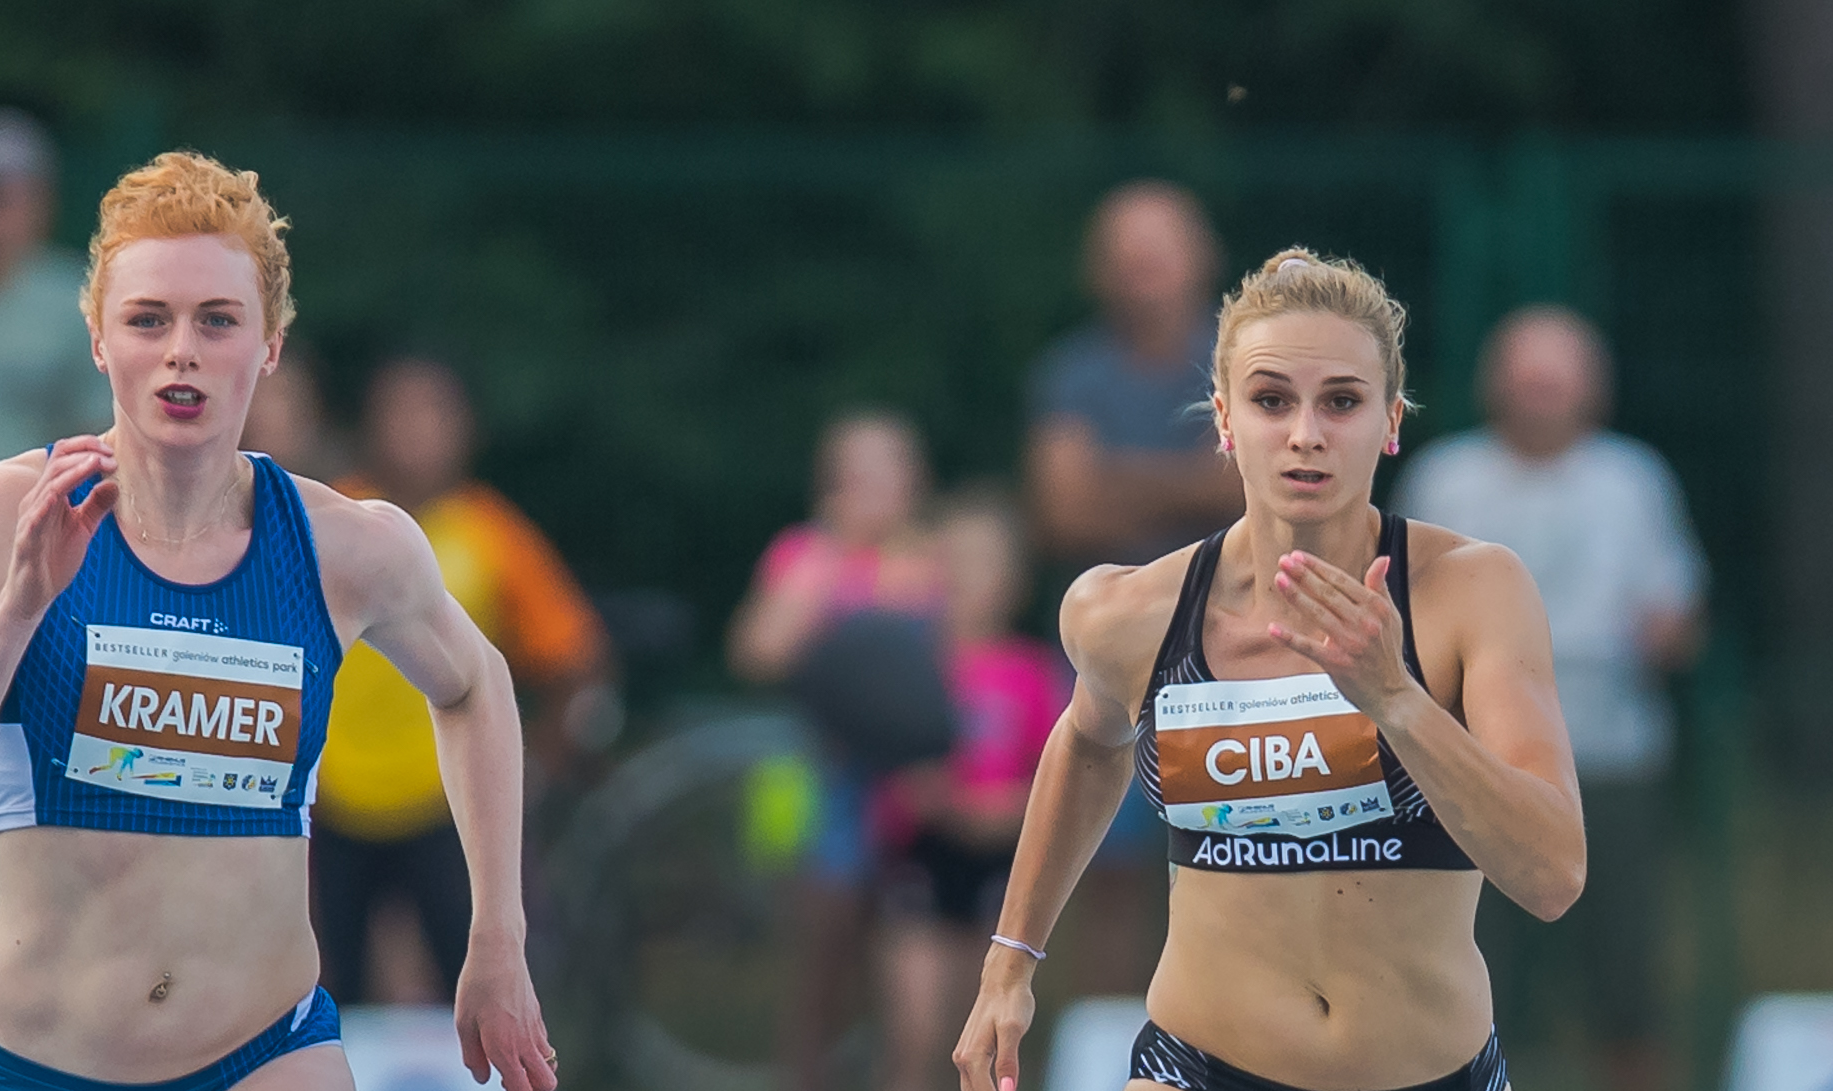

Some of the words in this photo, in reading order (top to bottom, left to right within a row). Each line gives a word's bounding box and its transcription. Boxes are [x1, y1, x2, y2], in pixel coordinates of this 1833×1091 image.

[150, 612, 211, 632] CRAFT
[95, 643, 167, 658] BESTSELLER
[221, 654, 269, 670] athletics
[272, 662, 298, 673] park
[99, 682, 284, 746] KRAMER
[1162, 701, 1234, 715] BESTSELLER
[1290, 690, 1339, 705] athletics
[1205, 732, 1331, 785] CIBA
